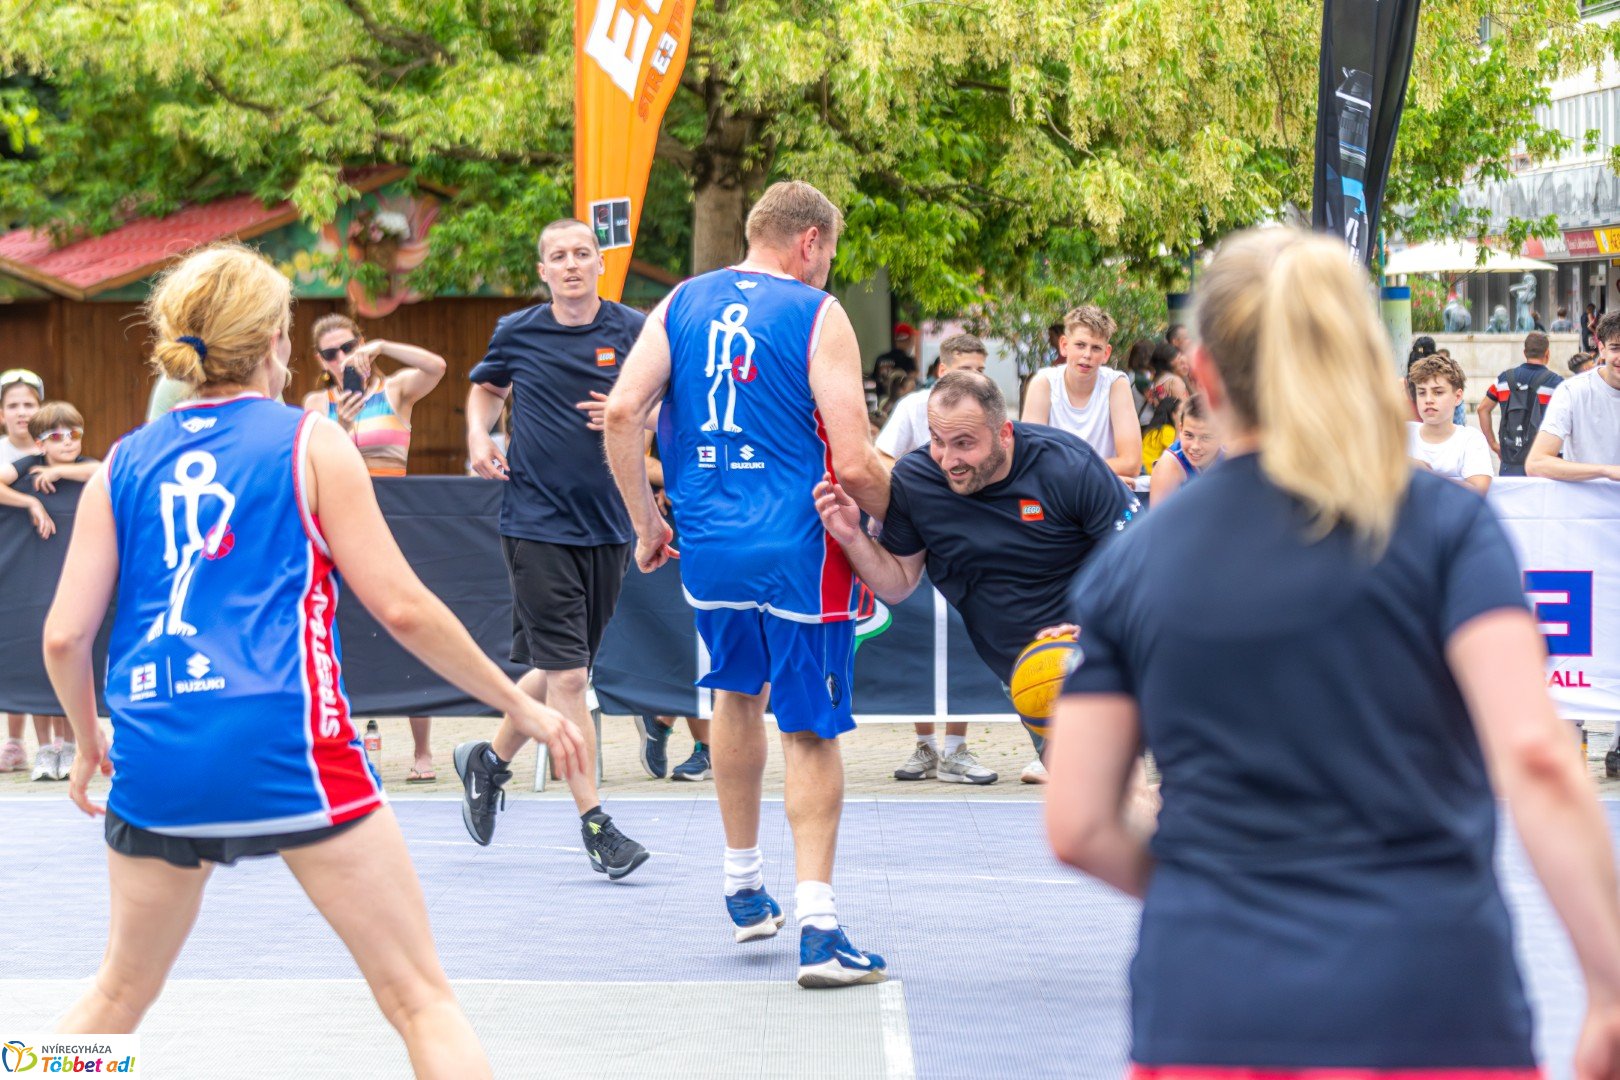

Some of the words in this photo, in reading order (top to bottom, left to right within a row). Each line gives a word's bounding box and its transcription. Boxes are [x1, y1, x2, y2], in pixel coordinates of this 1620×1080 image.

[730, 461, 765, 470] SUZUKI
[1023, 505, 1041, 515] LEGO
[174, 675, 226, 695] SUZUKI
[1548, 670, 1592, 688] ALL
